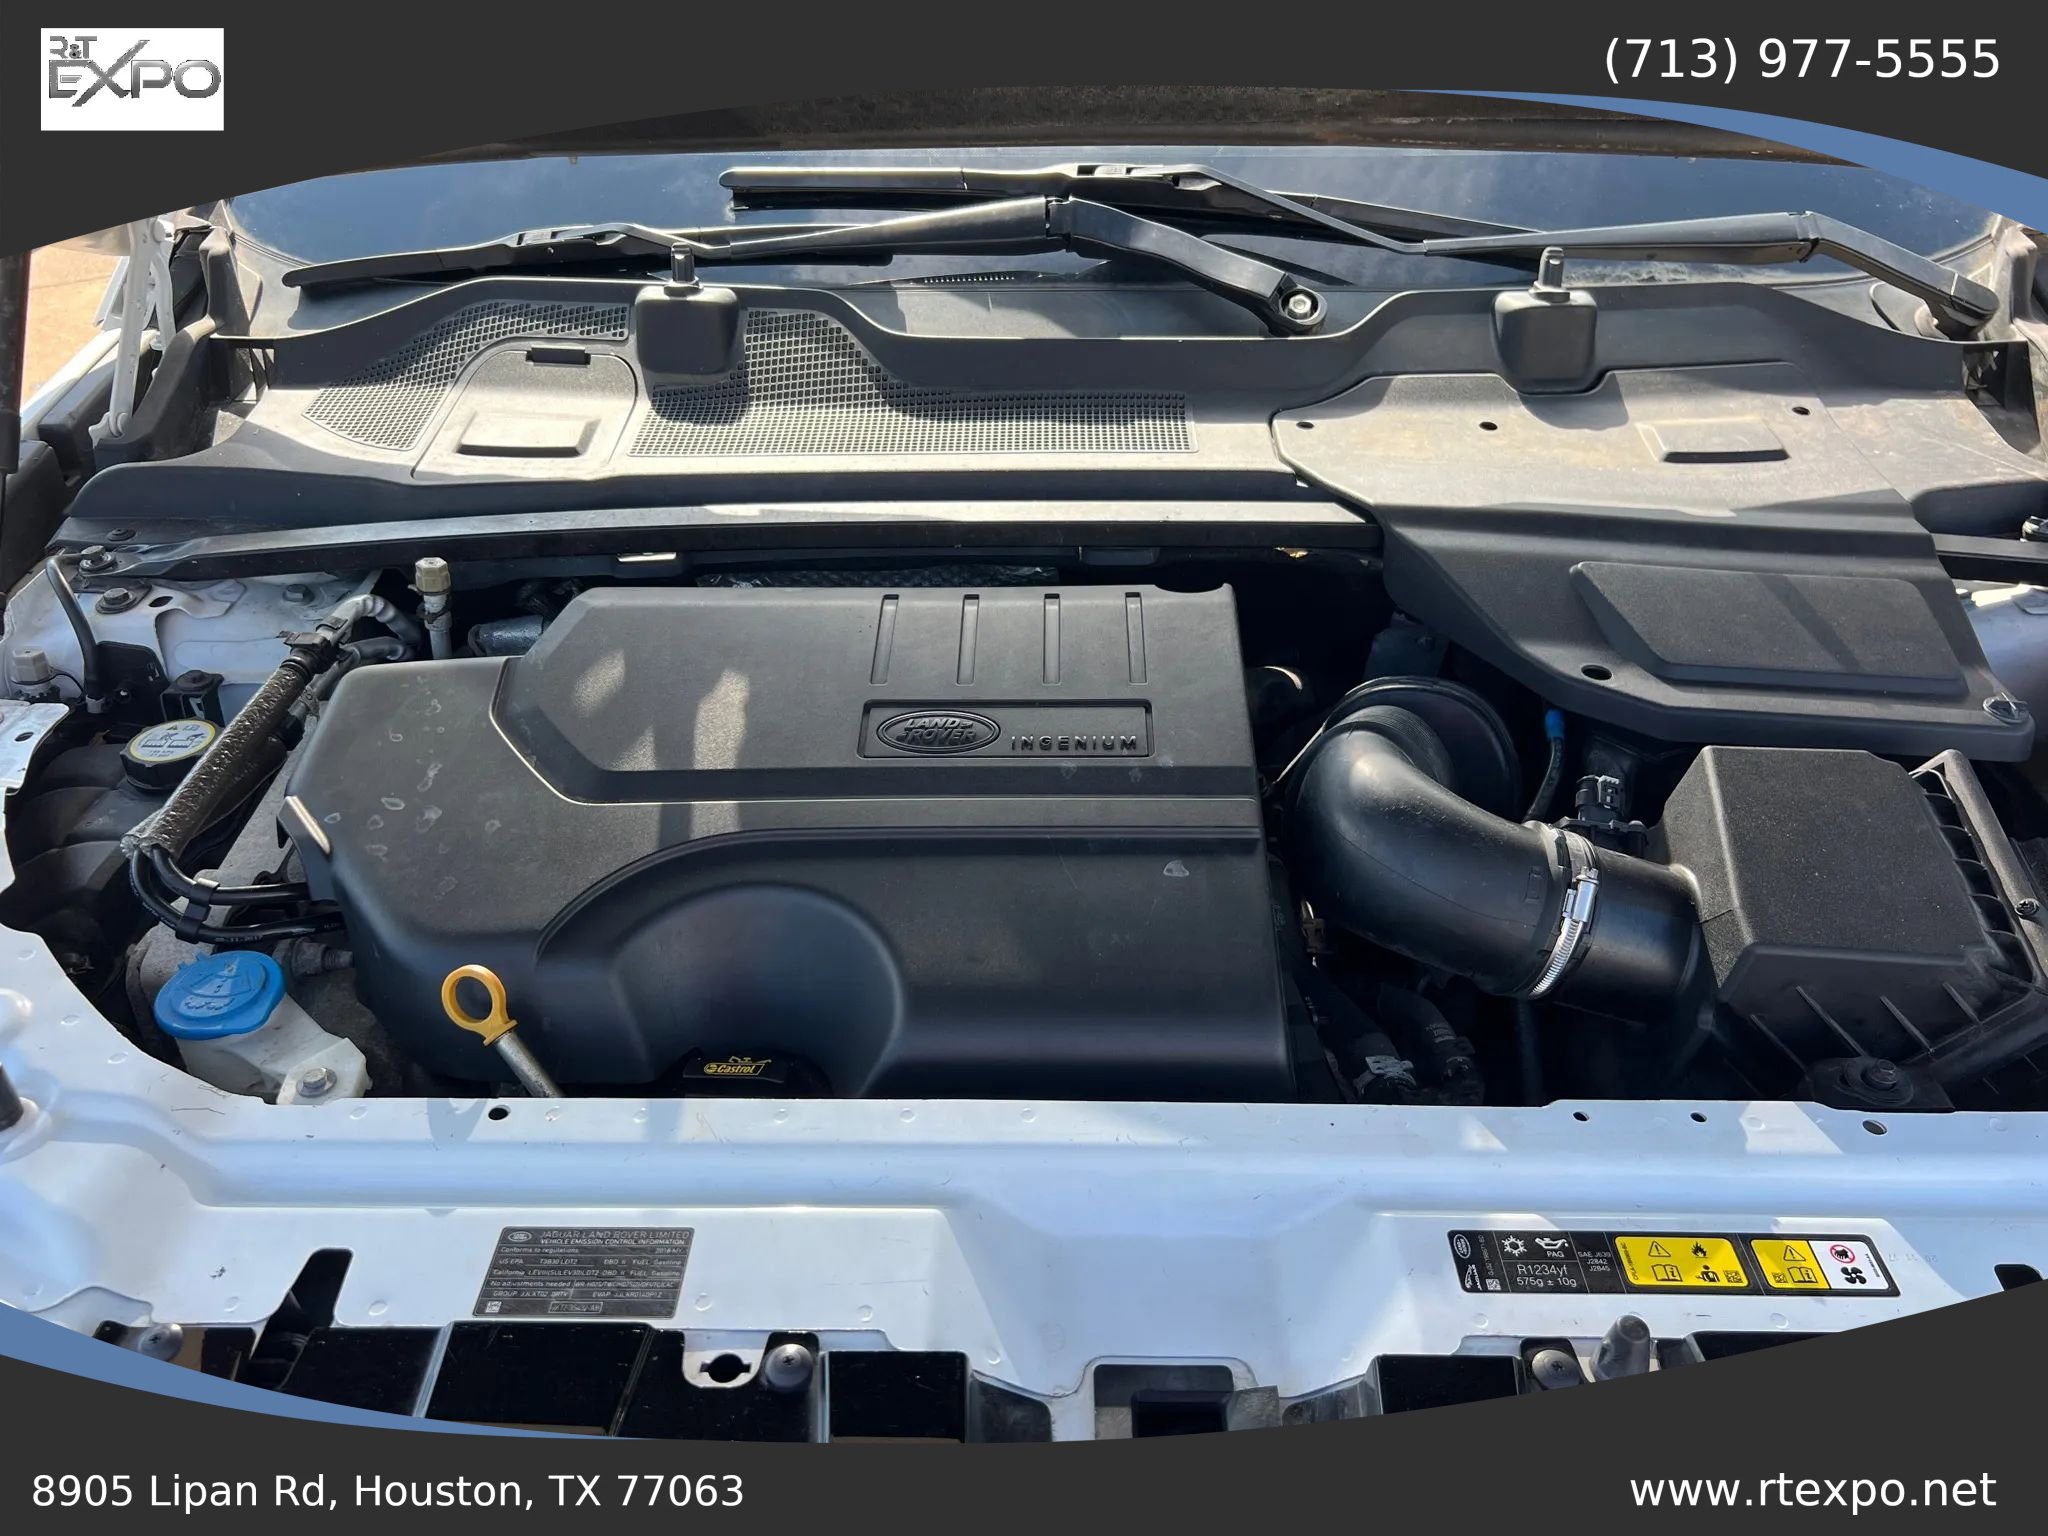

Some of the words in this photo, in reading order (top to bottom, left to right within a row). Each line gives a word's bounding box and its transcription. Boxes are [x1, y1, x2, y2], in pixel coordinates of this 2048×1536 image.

[904, 717, 963, 730] LAND
[902, 728, 976, 744] ROVER
[1011, 735, 1137, 751] INGENIUM
[717, 1065, 756, 1074] Castrol
[541, 1231, 580, 1239] JAGUAR
[583, 1231, 611, 1239] LAND
[614, 1231, 648, 1239] ROVER
[650, 1231, 690, 1239] LIMITED
[1517, 1264, 1568, 1277] R1234yf
[1517, 1277, 1544, 1287] 575g
[1557, 1277, 1577, 1287] 10g
